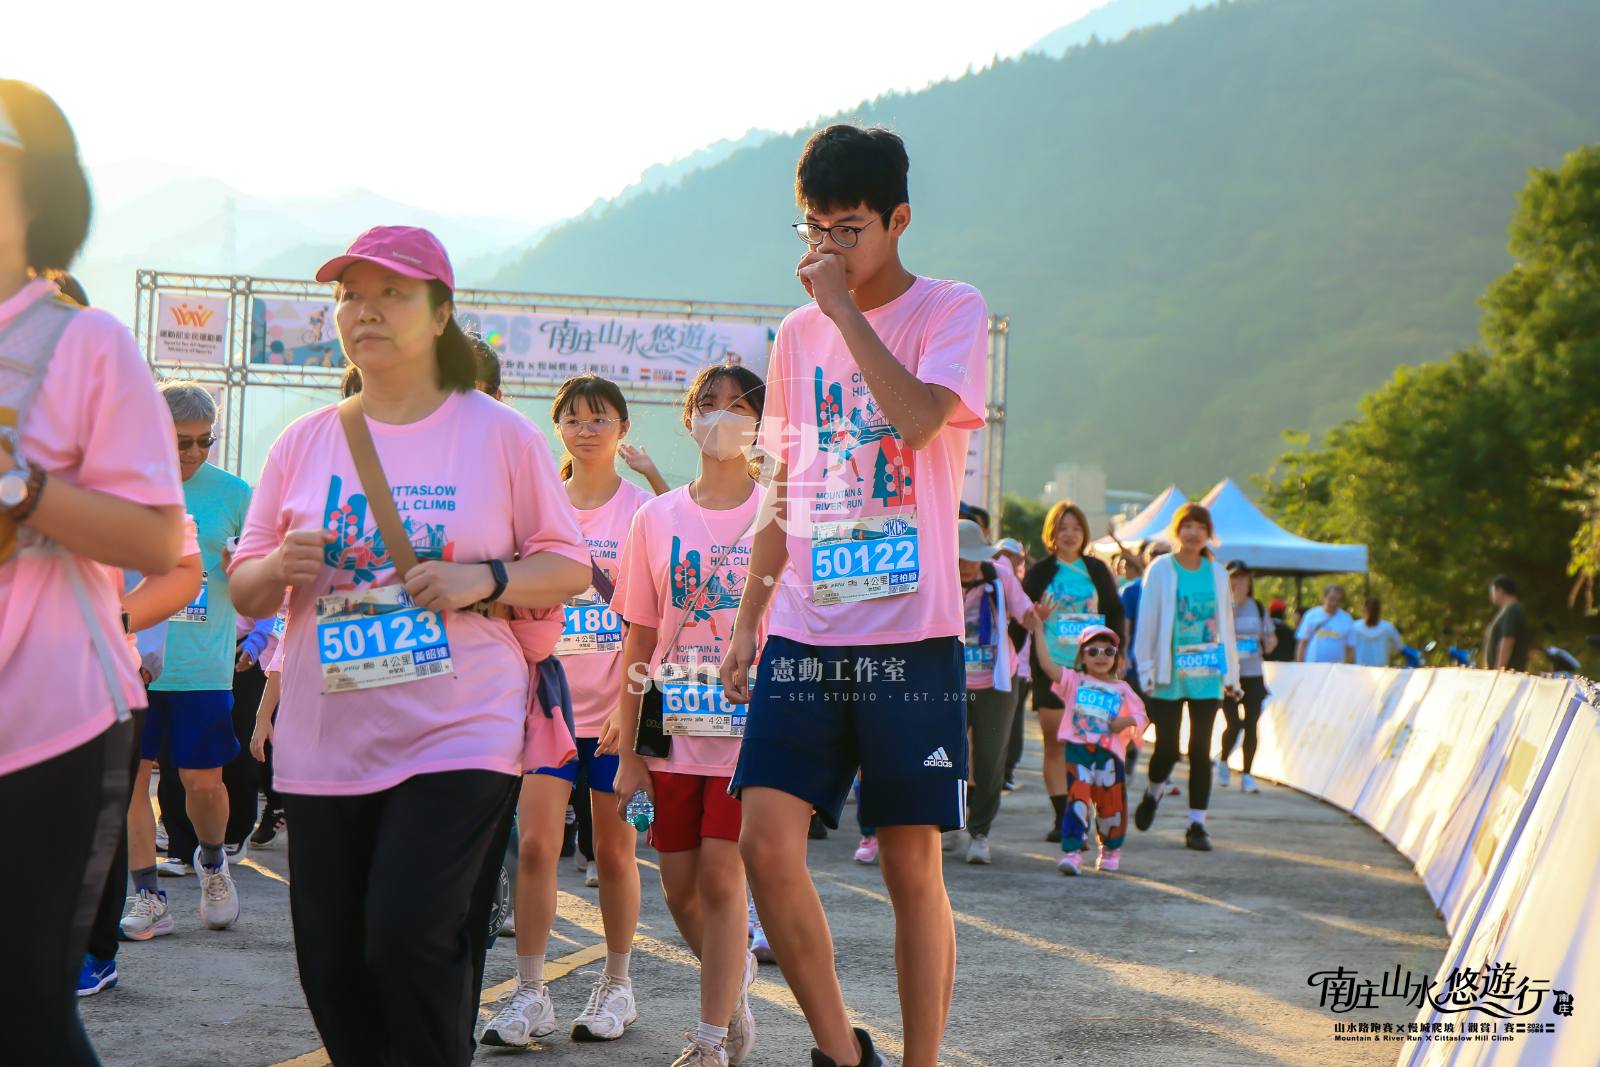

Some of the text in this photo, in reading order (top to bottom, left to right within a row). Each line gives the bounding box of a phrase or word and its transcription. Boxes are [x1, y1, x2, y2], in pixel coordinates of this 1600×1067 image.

[540, 318, 732, 365] 南庄山水悠遊行
[391, 485, 457, 497] ITTASLOW
[816, 487, 863, 499] MOUNTAIN &
[413, 500, 456, 512] CLIMB
[815, 499, 863, 511] RIVER RUN
[590, 549, 617, 560] CLIMB
[815, 540, 915, 577] 50122
[733, 556, 750, 566] CLI
[863, 575, 888, 587] 4公里
[563, 609, 617, 632] 180
[323, 611, 442, 660] 50123
[714, 645, 720, 653] &
[702, 655, 721, 663] RUN
[666, 687, 749, 713] 6018
[923, 758, 953, 768] adidas
